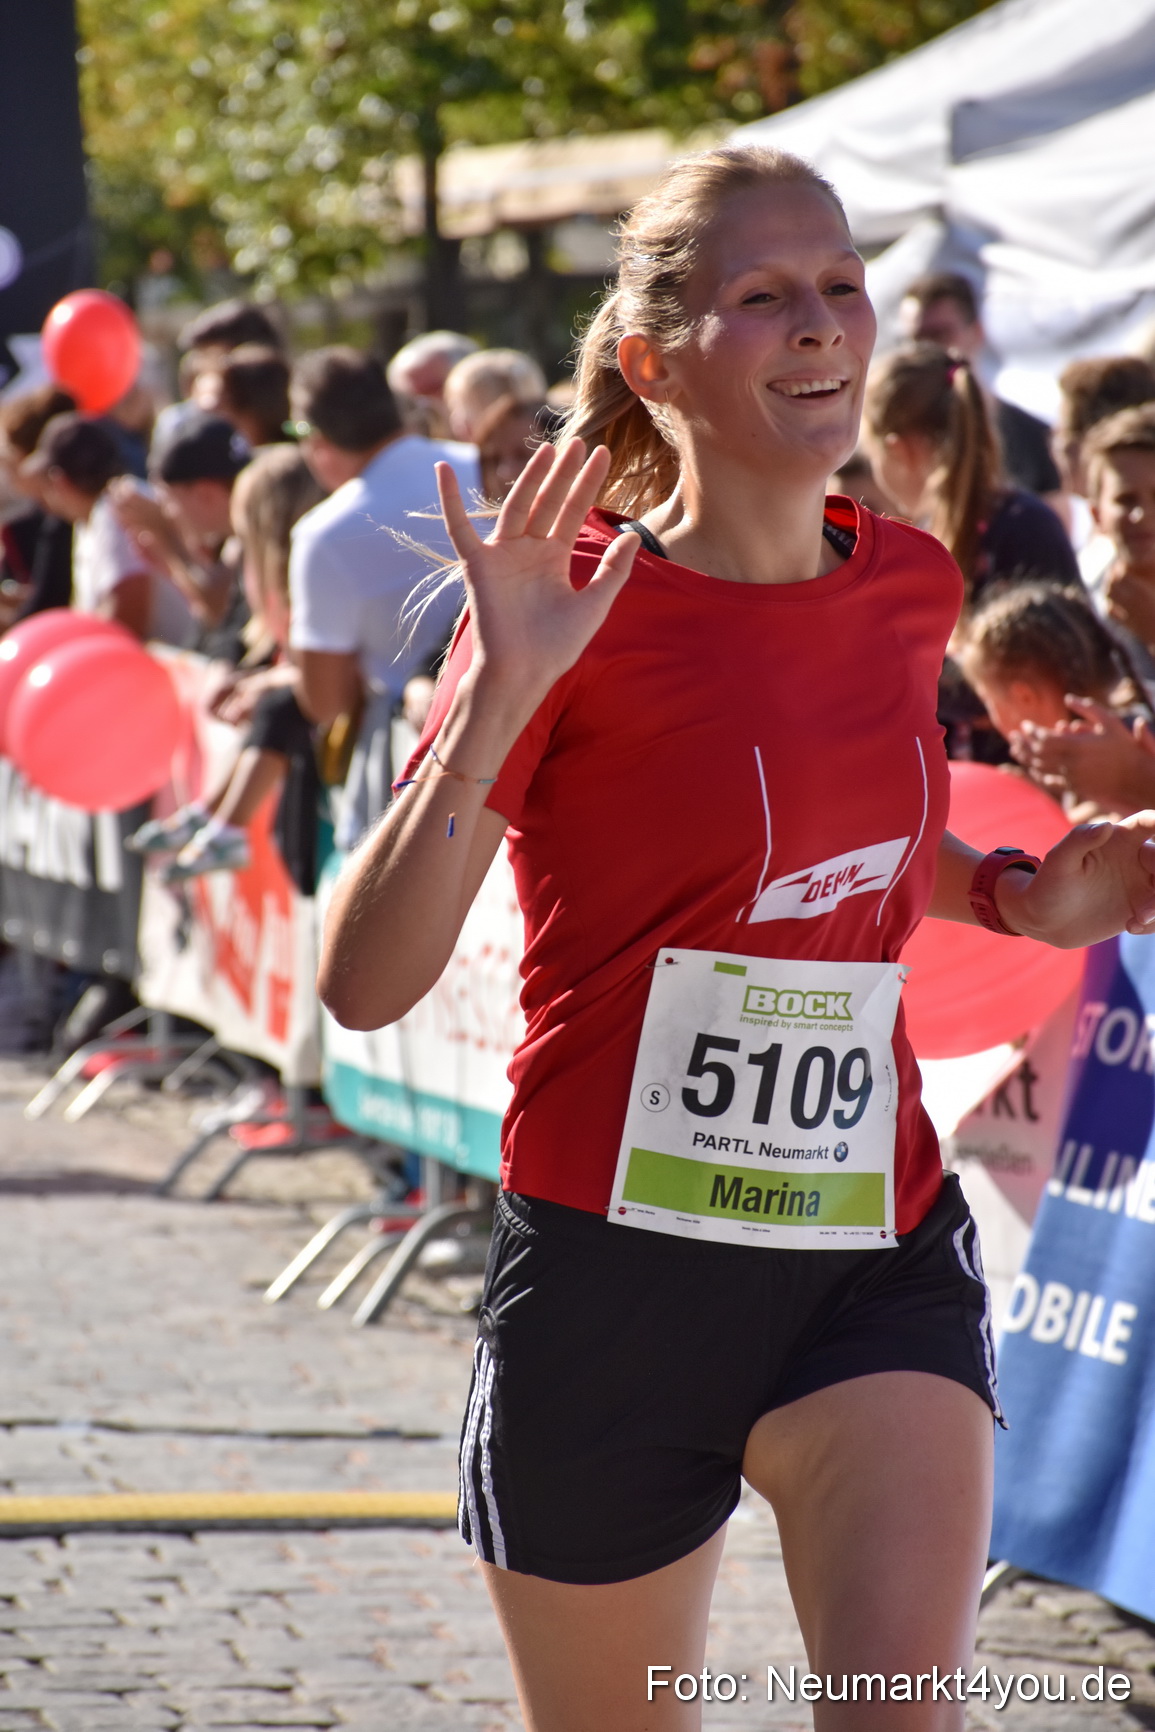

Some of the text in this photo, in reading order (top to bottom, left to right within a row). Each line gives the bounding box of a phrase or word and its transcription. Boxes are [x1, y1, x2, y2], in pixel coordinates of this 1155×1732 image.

[800, 862, 865, 903] DEHN
[742, 985, 853, 1021] BOCK
[740, 1014, 854, 1034] inspired by smart concepts
[649, 1090, 660, 1106] S
[681, 1032, 873, 1130] 5109
[692, 1131, 829, 1160] PARTL Neumarkt
[708, 1173, 821, 1218] Marina
